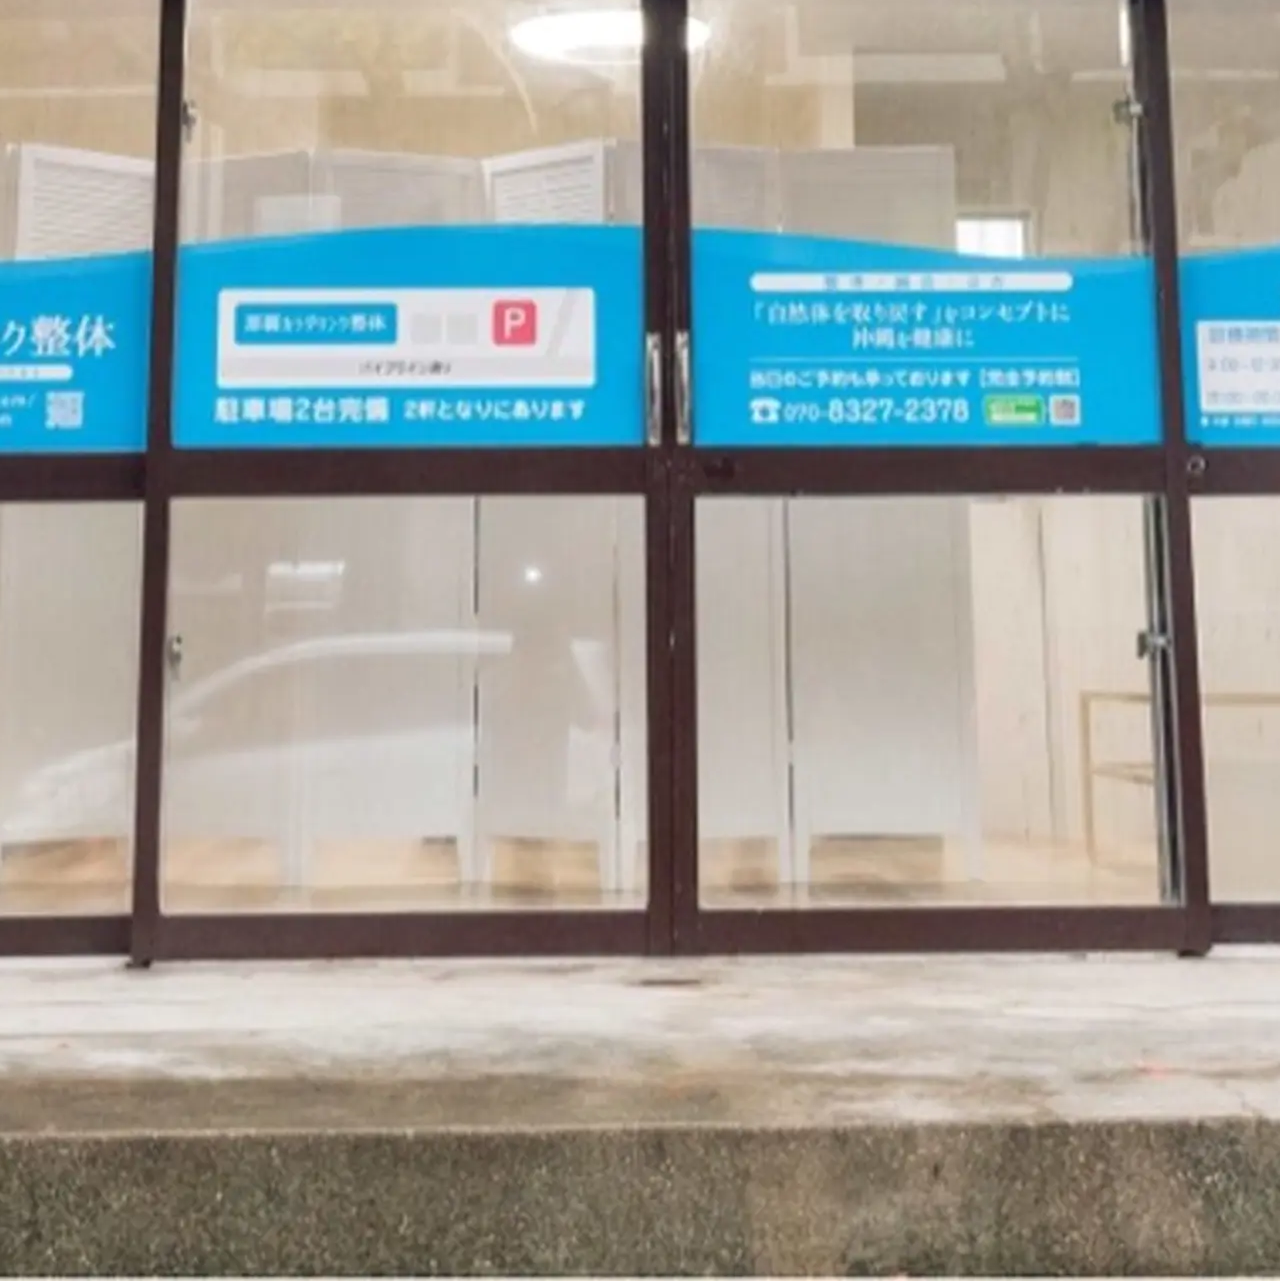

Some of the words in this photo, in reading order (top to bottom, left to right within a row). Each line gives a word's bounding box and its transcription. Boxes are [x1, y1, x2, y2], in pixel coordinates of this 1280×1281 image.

[503, 308, 527, 338] P
[213, 396, 390, 424] 駐車場2台完備
[783, 397, 970, 424] 070-8327-2378
